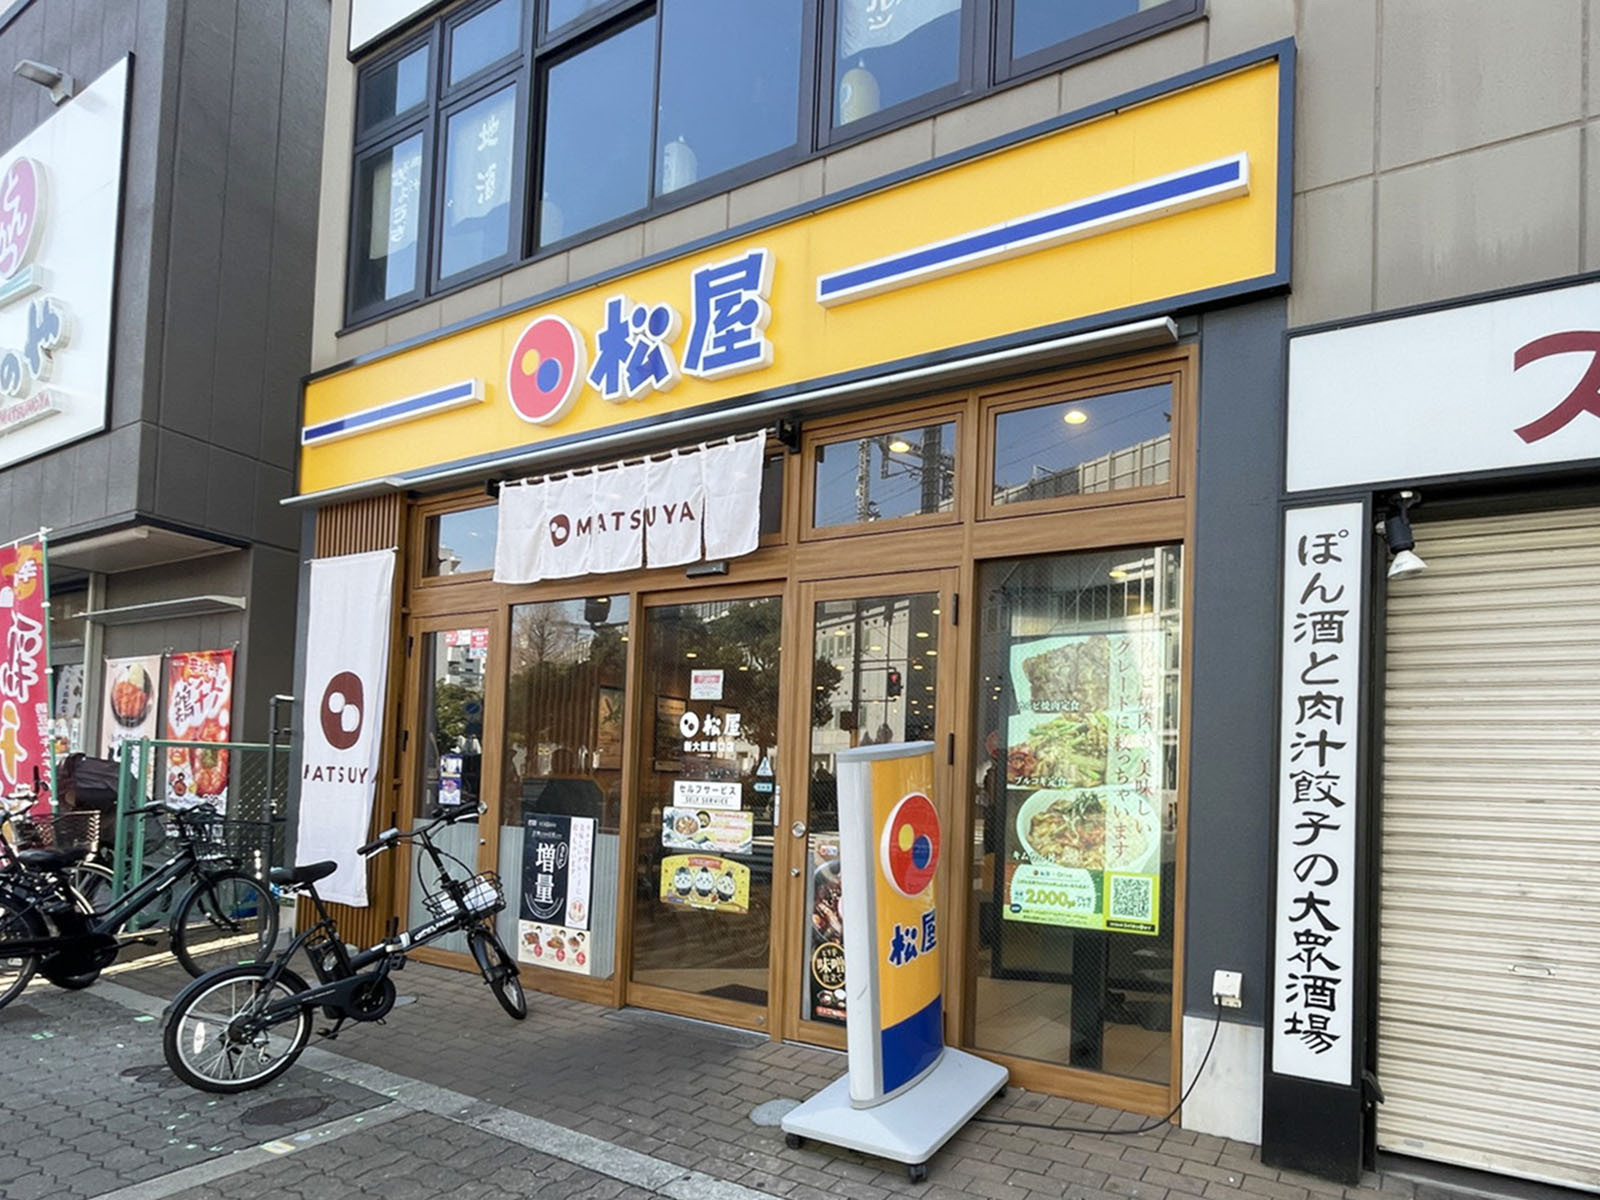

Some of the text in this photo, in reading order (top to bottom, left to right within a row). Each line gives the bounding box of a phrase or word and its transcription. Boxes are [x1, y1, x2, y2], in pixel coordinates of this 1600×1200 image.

[589, 250, 766, 397] 松屋
[576, 501, 696, 538] MATSUYA
[702, 713, 741, 736] 松屋
[303, 764, 378, 785] ATSUY
[679, 784, 736, 796] セルフサービス
[1283, 529, 1350, 1055] ぽん酒と肉汁餃子の大衆酒場
[533, 842, 557, 904] 増量
[889, 908, 937, 966] 松屋
